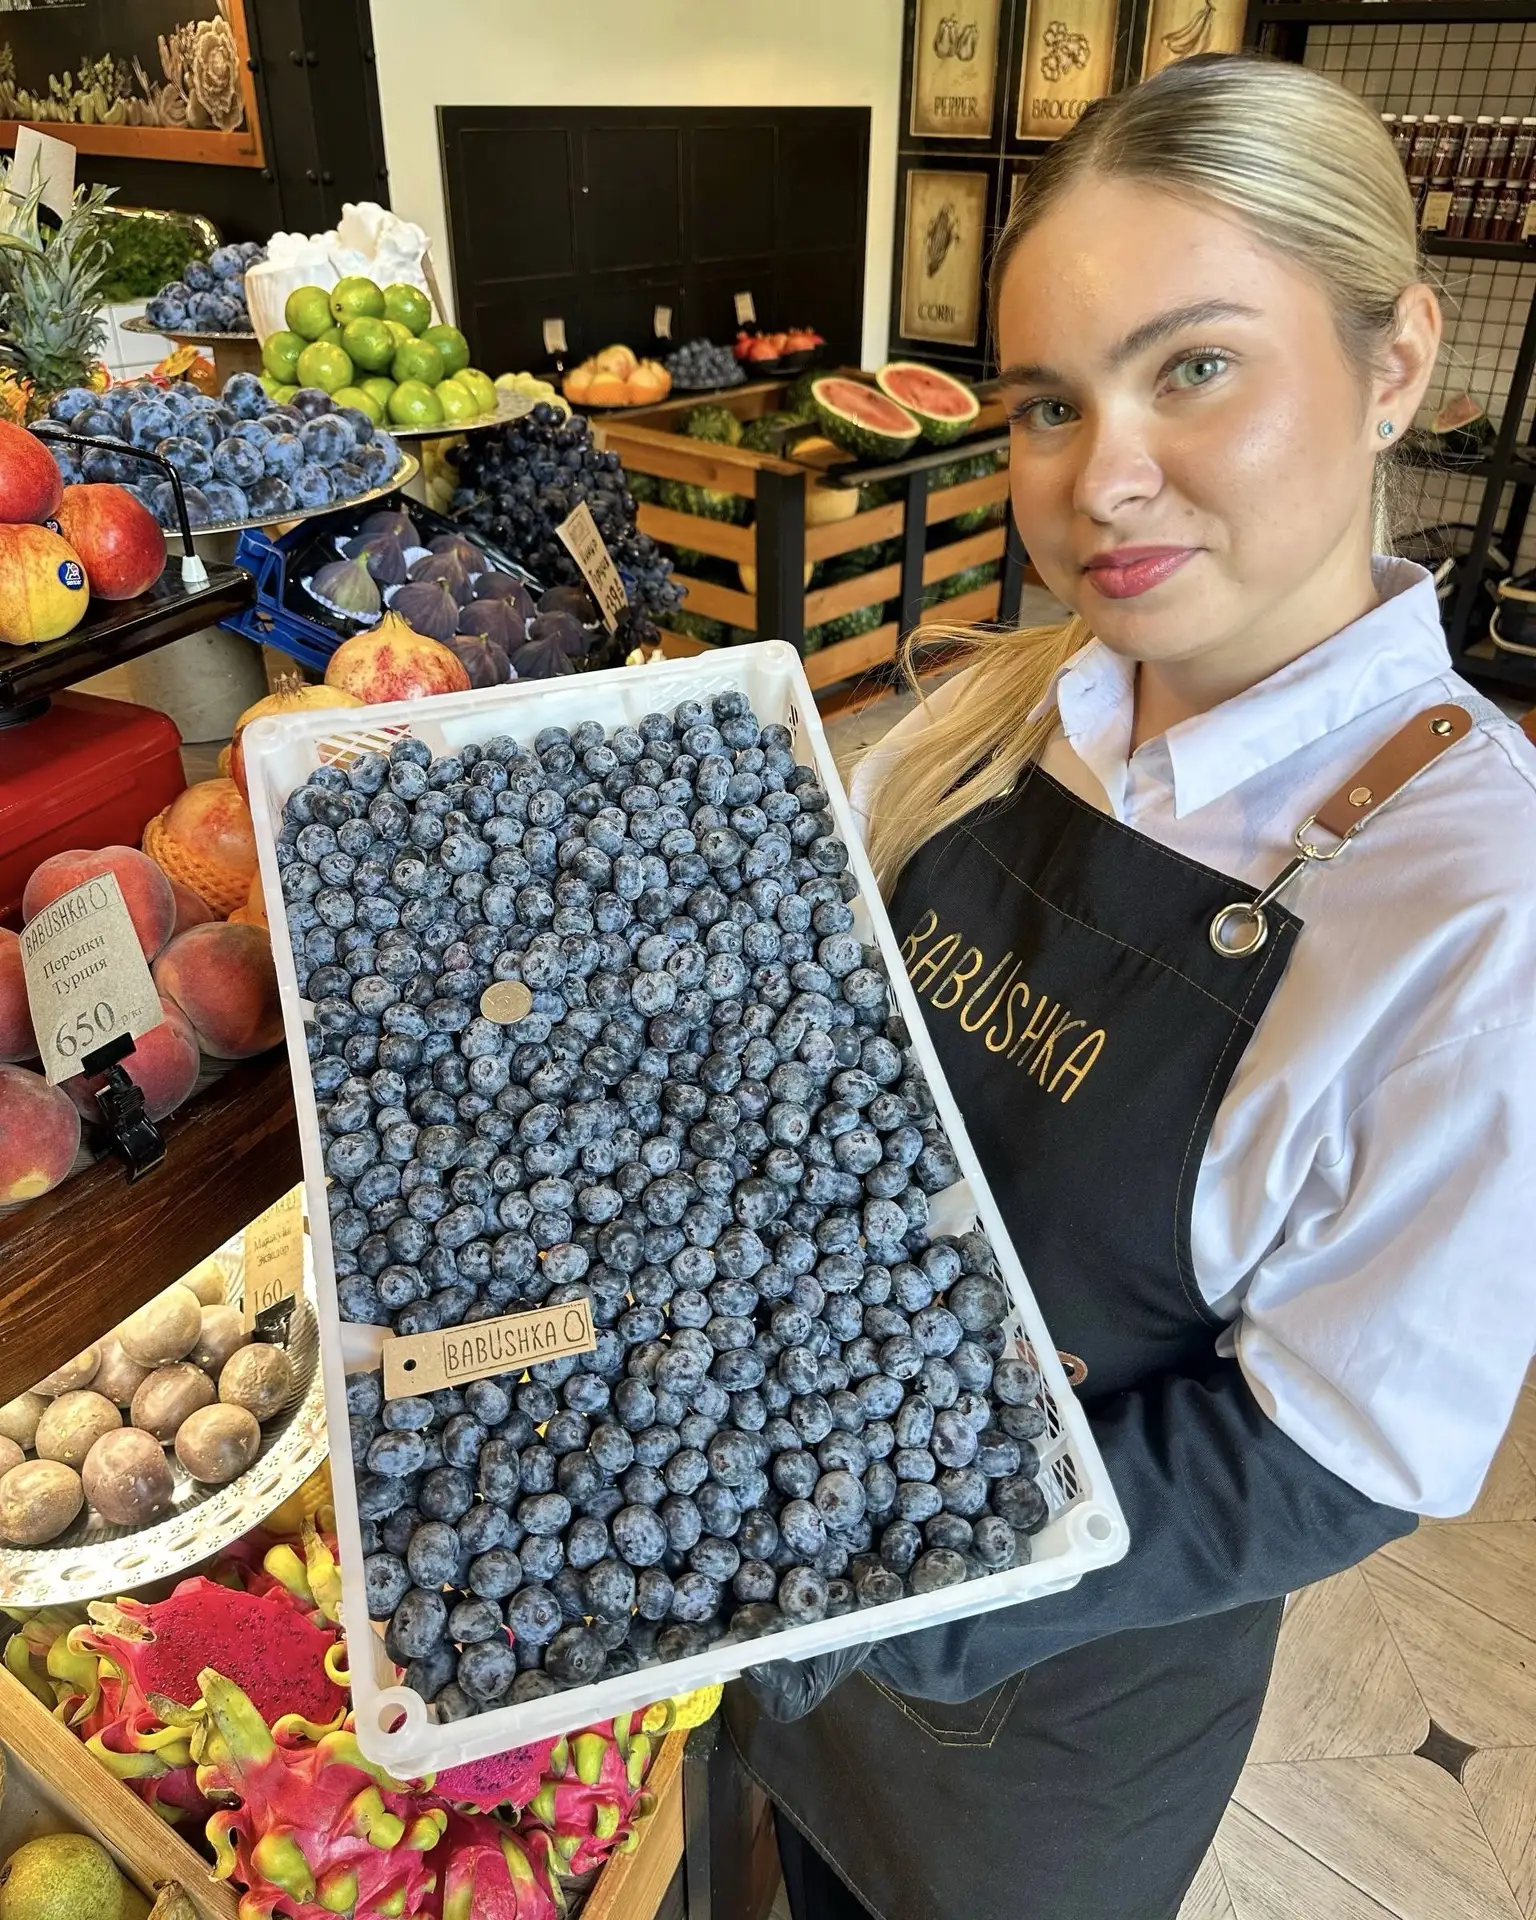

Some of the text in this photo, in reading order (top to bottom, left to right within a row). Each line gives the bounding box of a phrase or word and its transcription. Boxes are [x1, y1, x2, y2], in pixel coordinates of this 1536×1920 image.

[933, 96, 979, 118] PEPPER
[917, 303, 956, 322] CORN
[25, 895, 89, 958] BABUSHKA
[42, 934, 106, 980] Персики
[51, 956, 109, 996] Турция
[900, 908, 1106, 1103] BABUSHKA
[55, 1001, 145, 1058] 650 р/кг
[253, 1278, 283, 1313] 160
[447, 1320, 558, 1372] BABUSHKA
